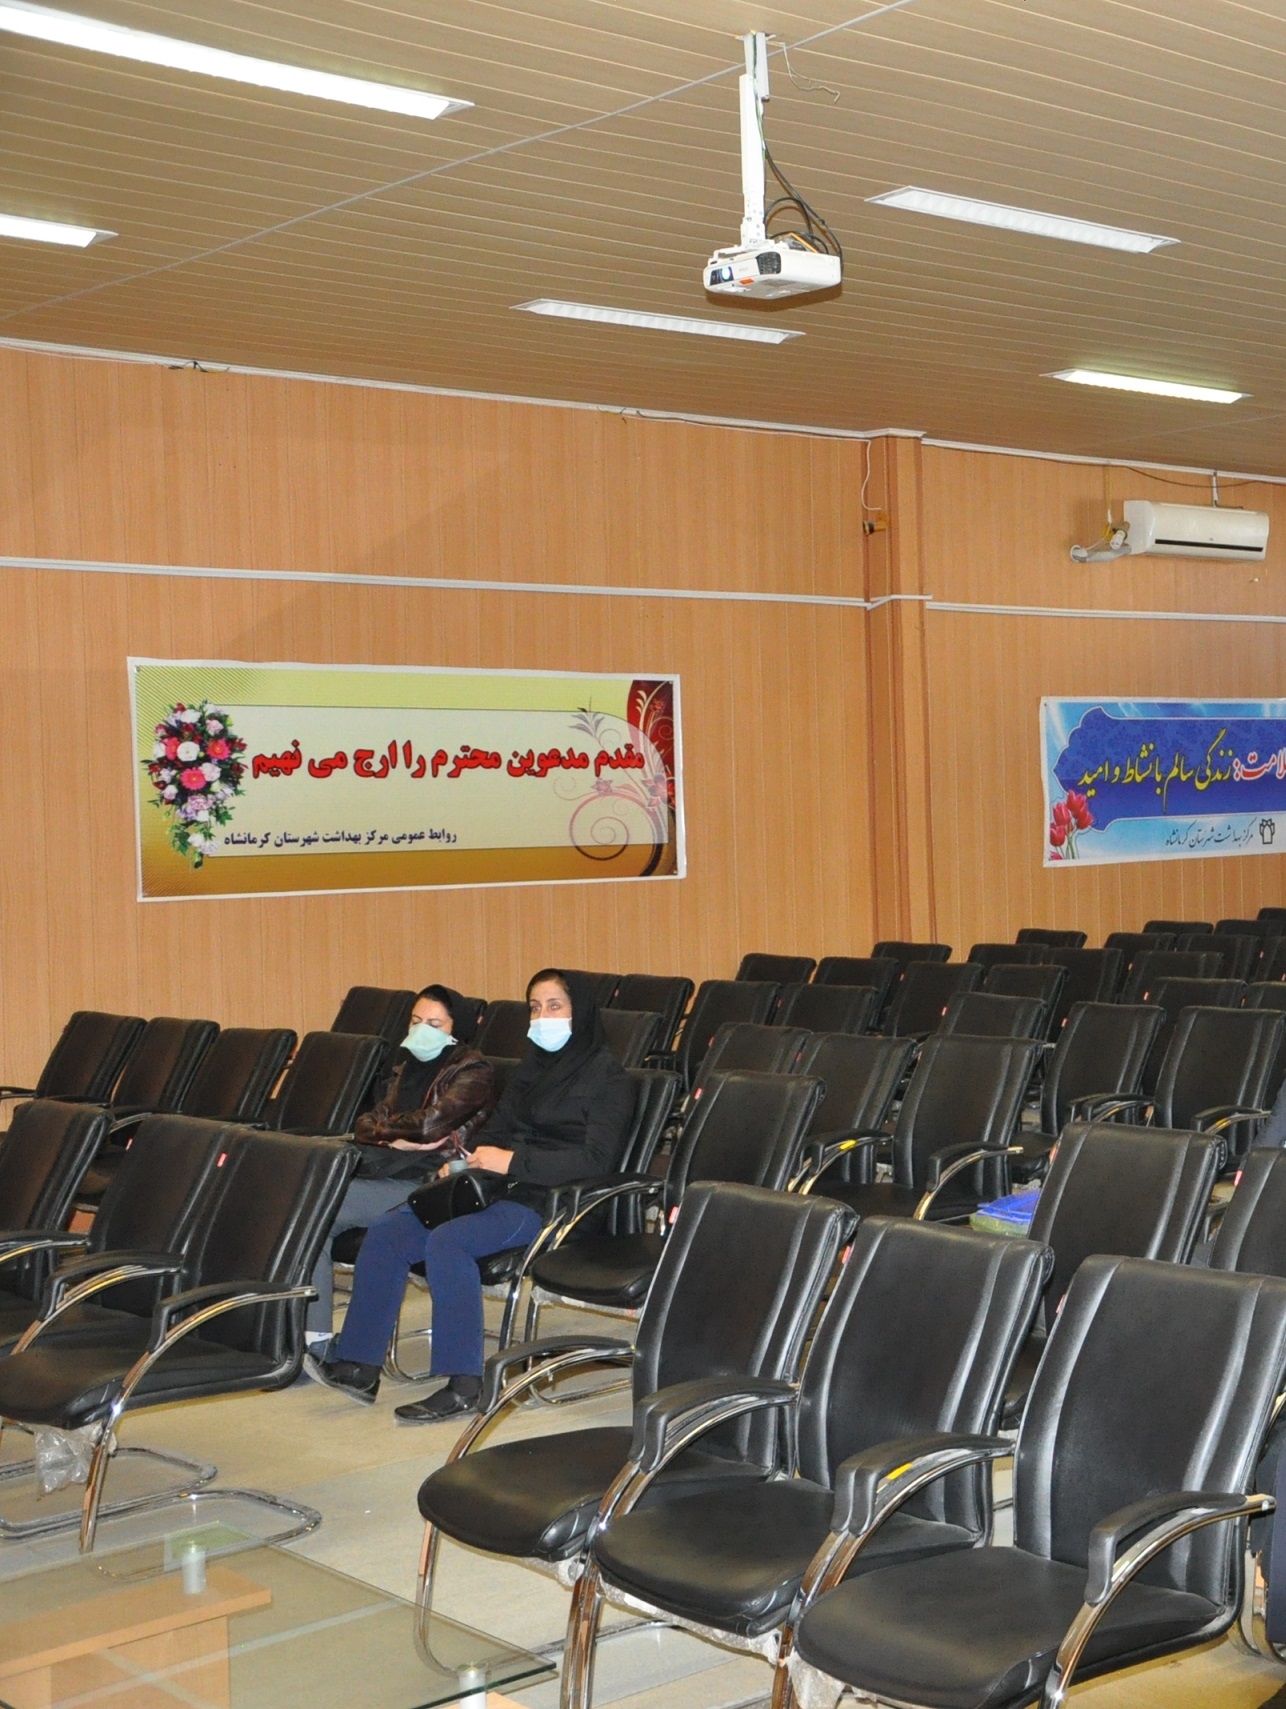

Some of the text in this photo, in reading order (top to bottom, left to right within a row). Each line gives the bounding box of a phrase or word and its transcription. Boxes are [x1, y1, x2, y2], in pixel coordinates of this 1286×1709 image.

[252, 739, 645, 780] مقدم مدعوین محترم را ارج می نهیم
[223, 827, 458, 849] روابط عمومی مرکز بهداشت شهرستان کرمانشاه
